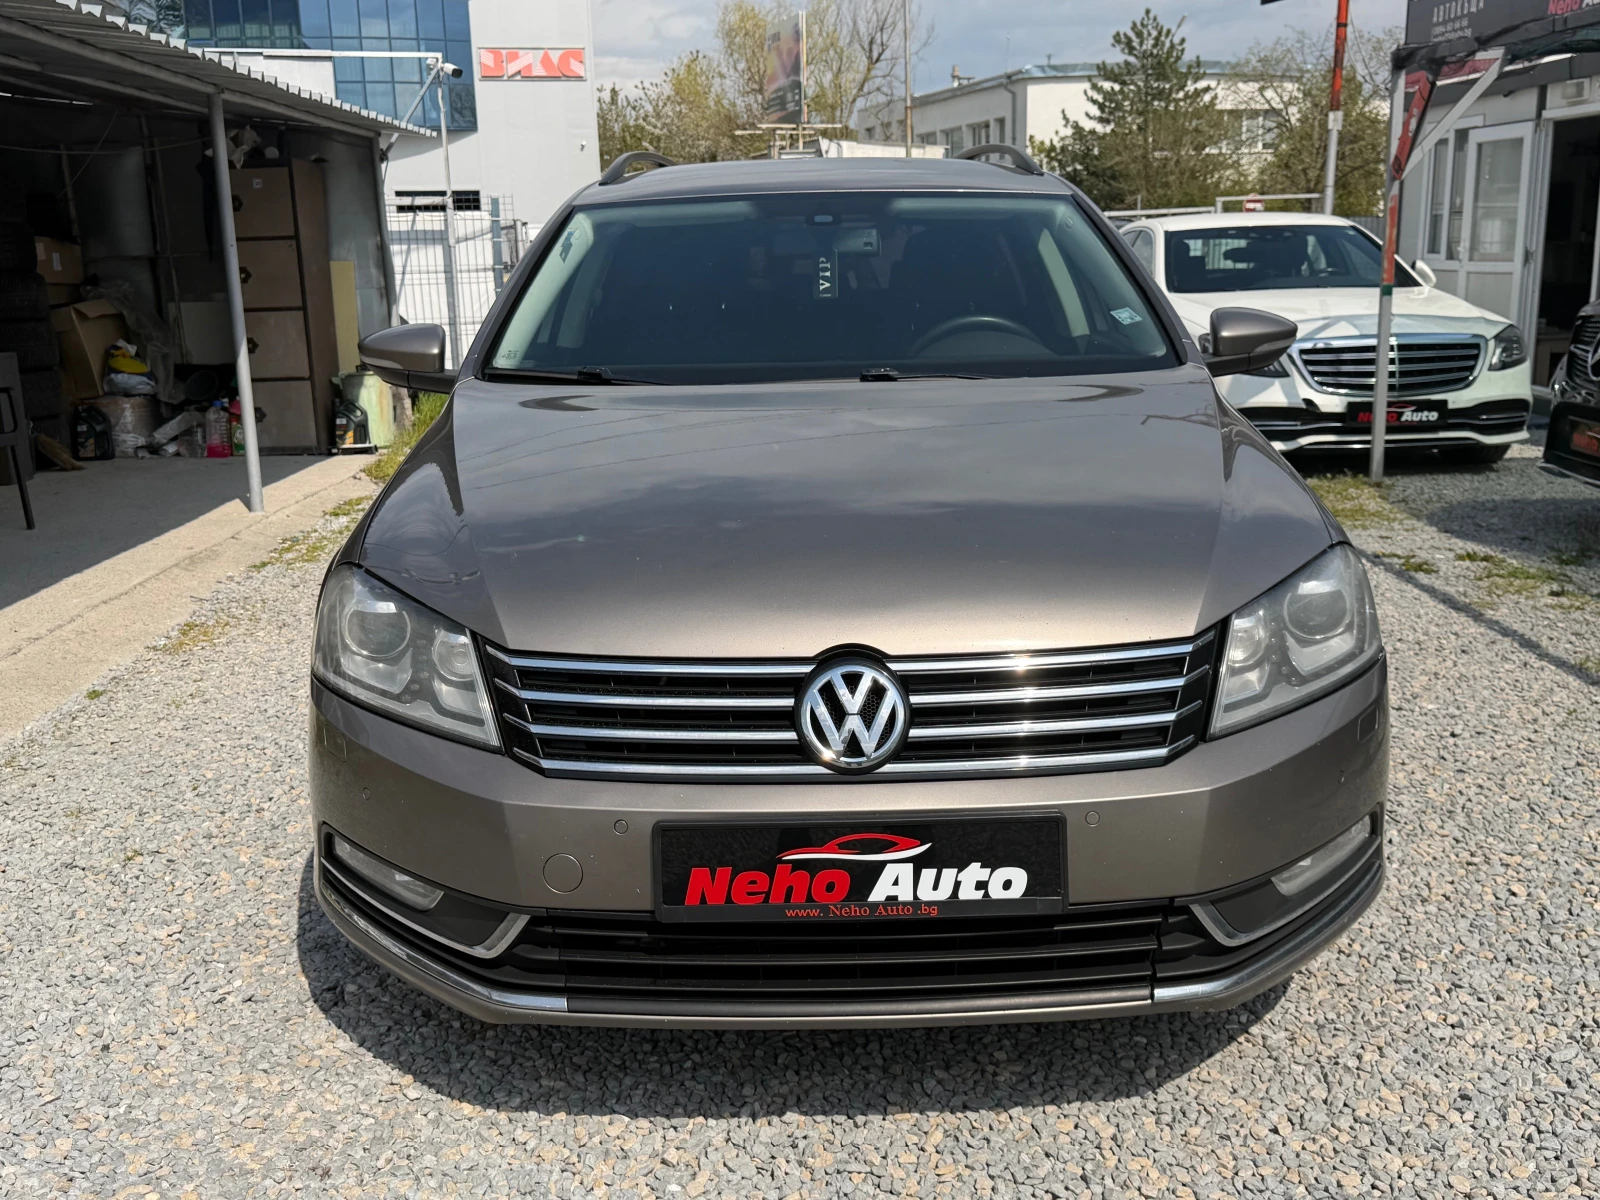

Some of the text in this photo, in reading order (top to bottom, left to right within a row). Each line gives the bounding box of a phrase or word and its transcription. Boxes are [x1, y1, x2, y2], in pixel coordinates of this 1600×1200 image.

[819, 257, 831, 291] VIP
[1400, 410, 1439, 422] Auto
[684, 861, 1028, 906] Neho Auto
[785, 903, 938, 917] www. Neho Auto .bg
